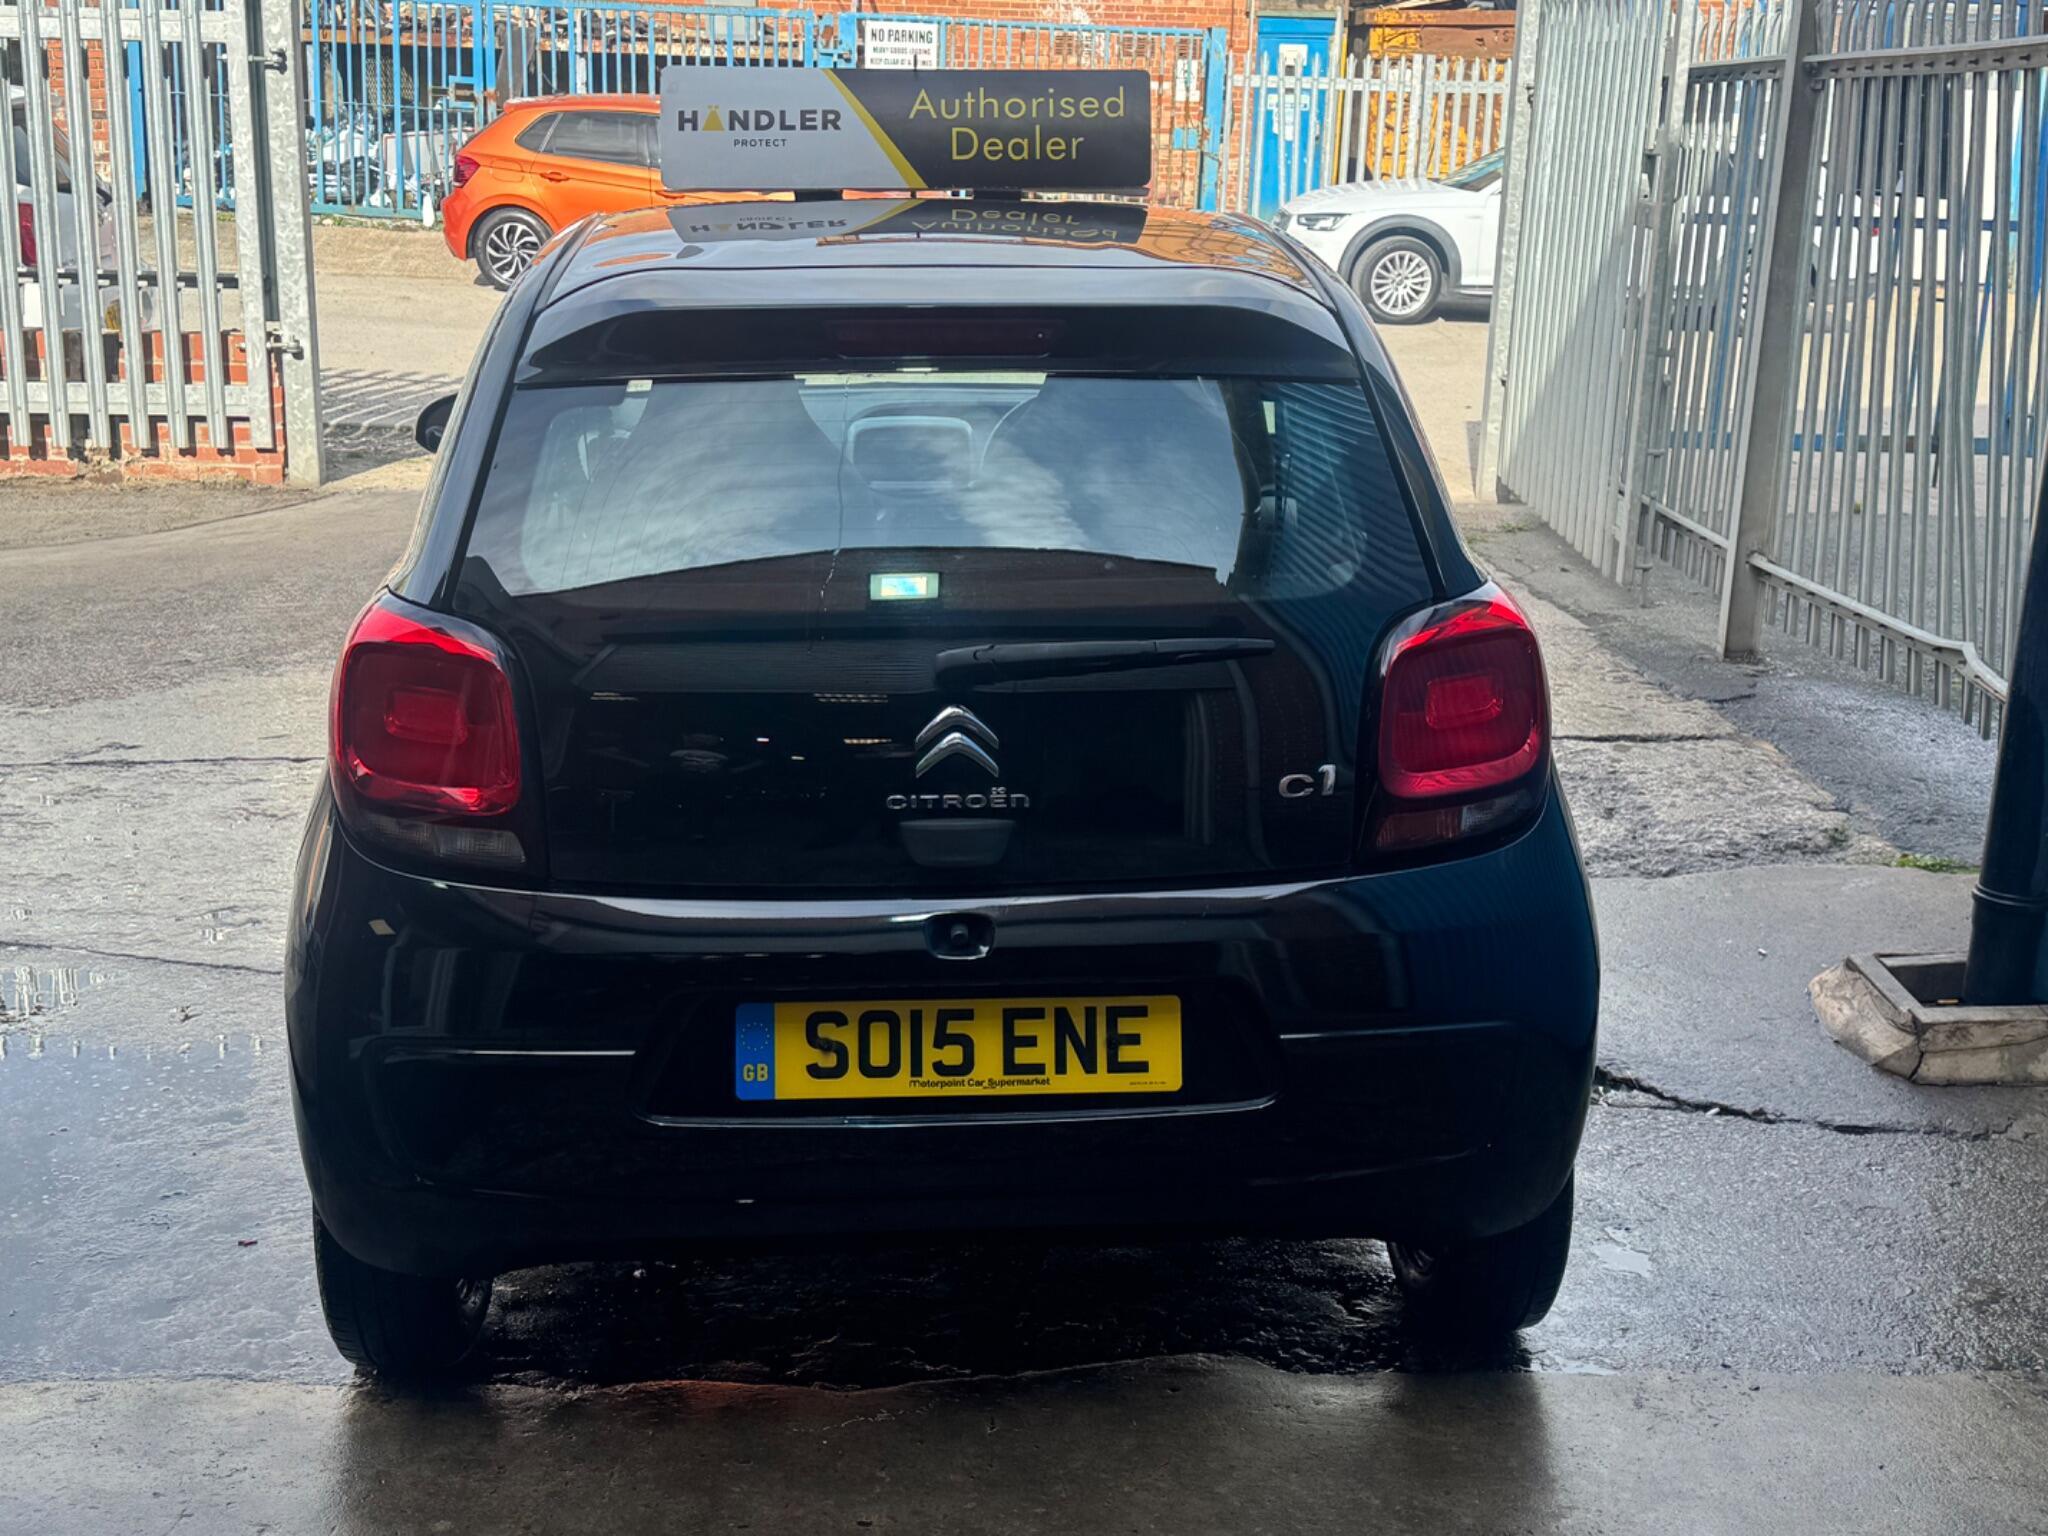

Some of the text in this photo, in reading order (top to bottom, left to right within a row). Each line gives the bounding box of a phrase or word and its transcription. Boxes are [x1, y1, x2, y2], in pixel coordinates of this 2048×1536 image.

[871, 28, 933, 44] NO PARKING
[908, 86, 1125, 120] Authorised
[733, 138, 787, 147] PROTECT
[951, 126, 1085, 161] Dealer
[1279, 764, 1337, 798] C1
[1002, 1006, 1149, 1075] ENE
[742, 1063, 769, 1082] GB
[909, 1077, 1050, 1089] Motorpoint Car Supermarket
